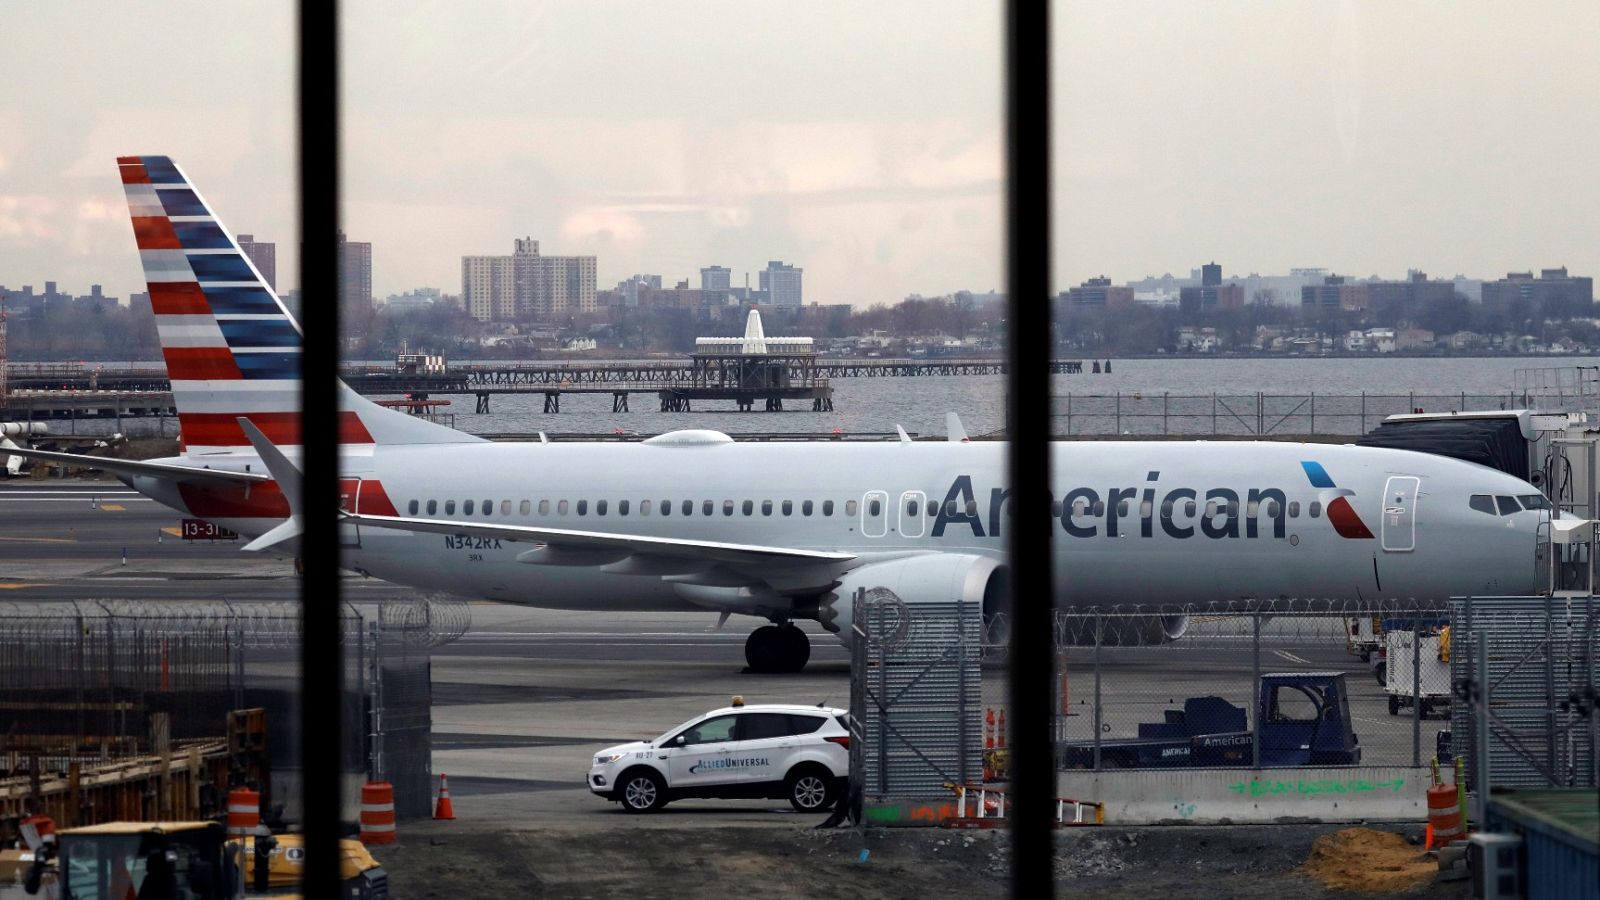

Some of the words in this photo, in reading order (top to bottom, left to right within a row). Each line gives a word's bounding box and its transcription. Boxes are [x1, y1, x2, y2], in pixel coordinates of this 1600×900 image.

[185, 523, 219, 536] 13-31
[445, 535, 502, 550] N342RX
[1203, 735, 1253, 747] American
